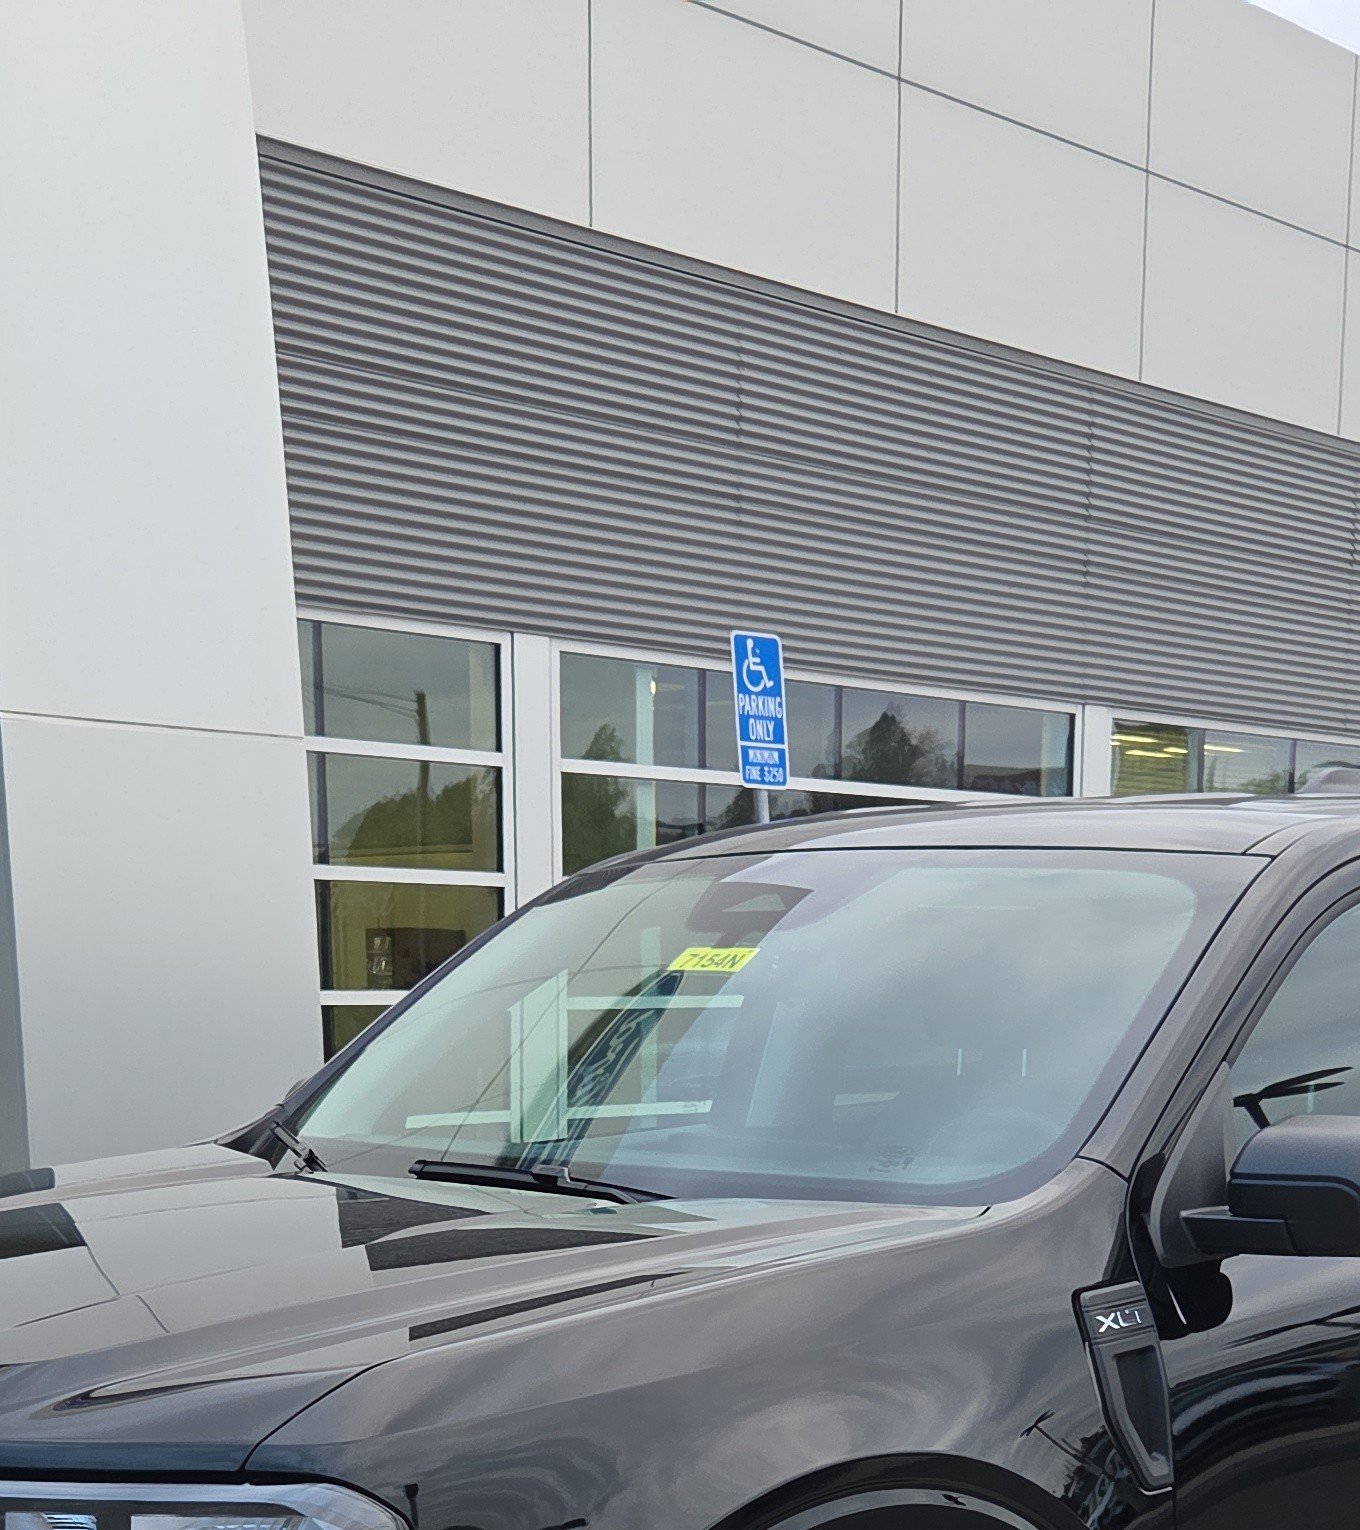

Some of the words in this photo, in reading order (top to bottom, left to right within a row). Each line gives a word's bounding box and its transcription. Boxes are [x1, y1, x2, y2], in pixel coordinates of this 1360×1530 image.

[738, 693, 783, 719] PARKING
[748, 718, 774, 741] ONLY
[745, 765, 761, 781] FINE
[764, 766, 784, 783] $250
[1095, 1309, 1143, 1333] XLT
